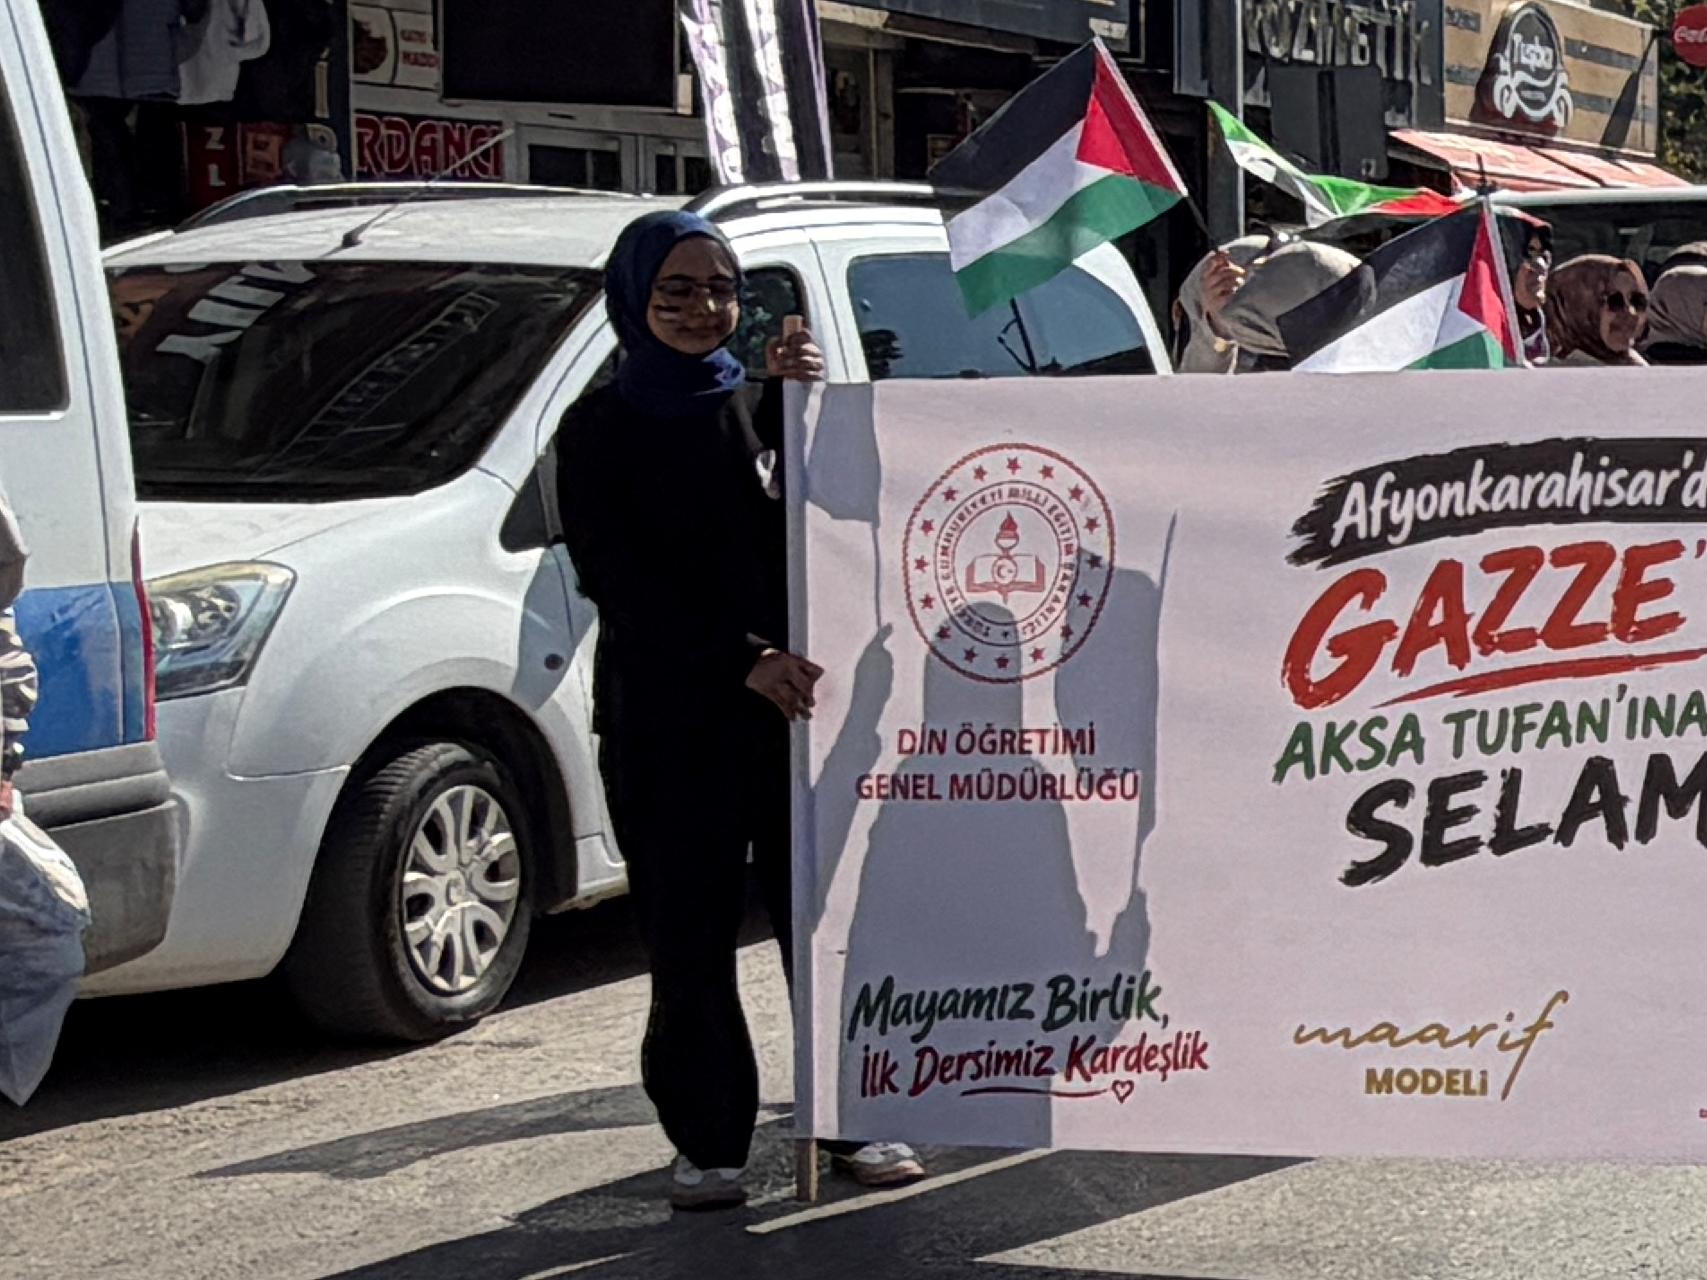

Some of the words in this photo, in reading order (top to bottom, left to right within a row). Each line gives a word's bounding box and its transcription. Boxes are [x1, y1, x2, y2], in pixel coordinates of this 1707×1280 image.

[897, 721, 947, 755] DİN
[955, 721, 1097, 755] ÖĞRETİMİ
[1272, 712, 1425, 784] AKSA
[855, 772, 942, 801] GENEL
[948, 767, 1141, 802] MÜDÜRLÜĞÜ
[847, 974, 1036, 1043] Mayamız
[1040, 970, 1170, 1033] Birlik,
[908, 1038, 1056, 1097] Dersimiz
[1065, 1030, 1210, 1083] Kardeşlik
[1292, 989, 1570, 1101] maarif
